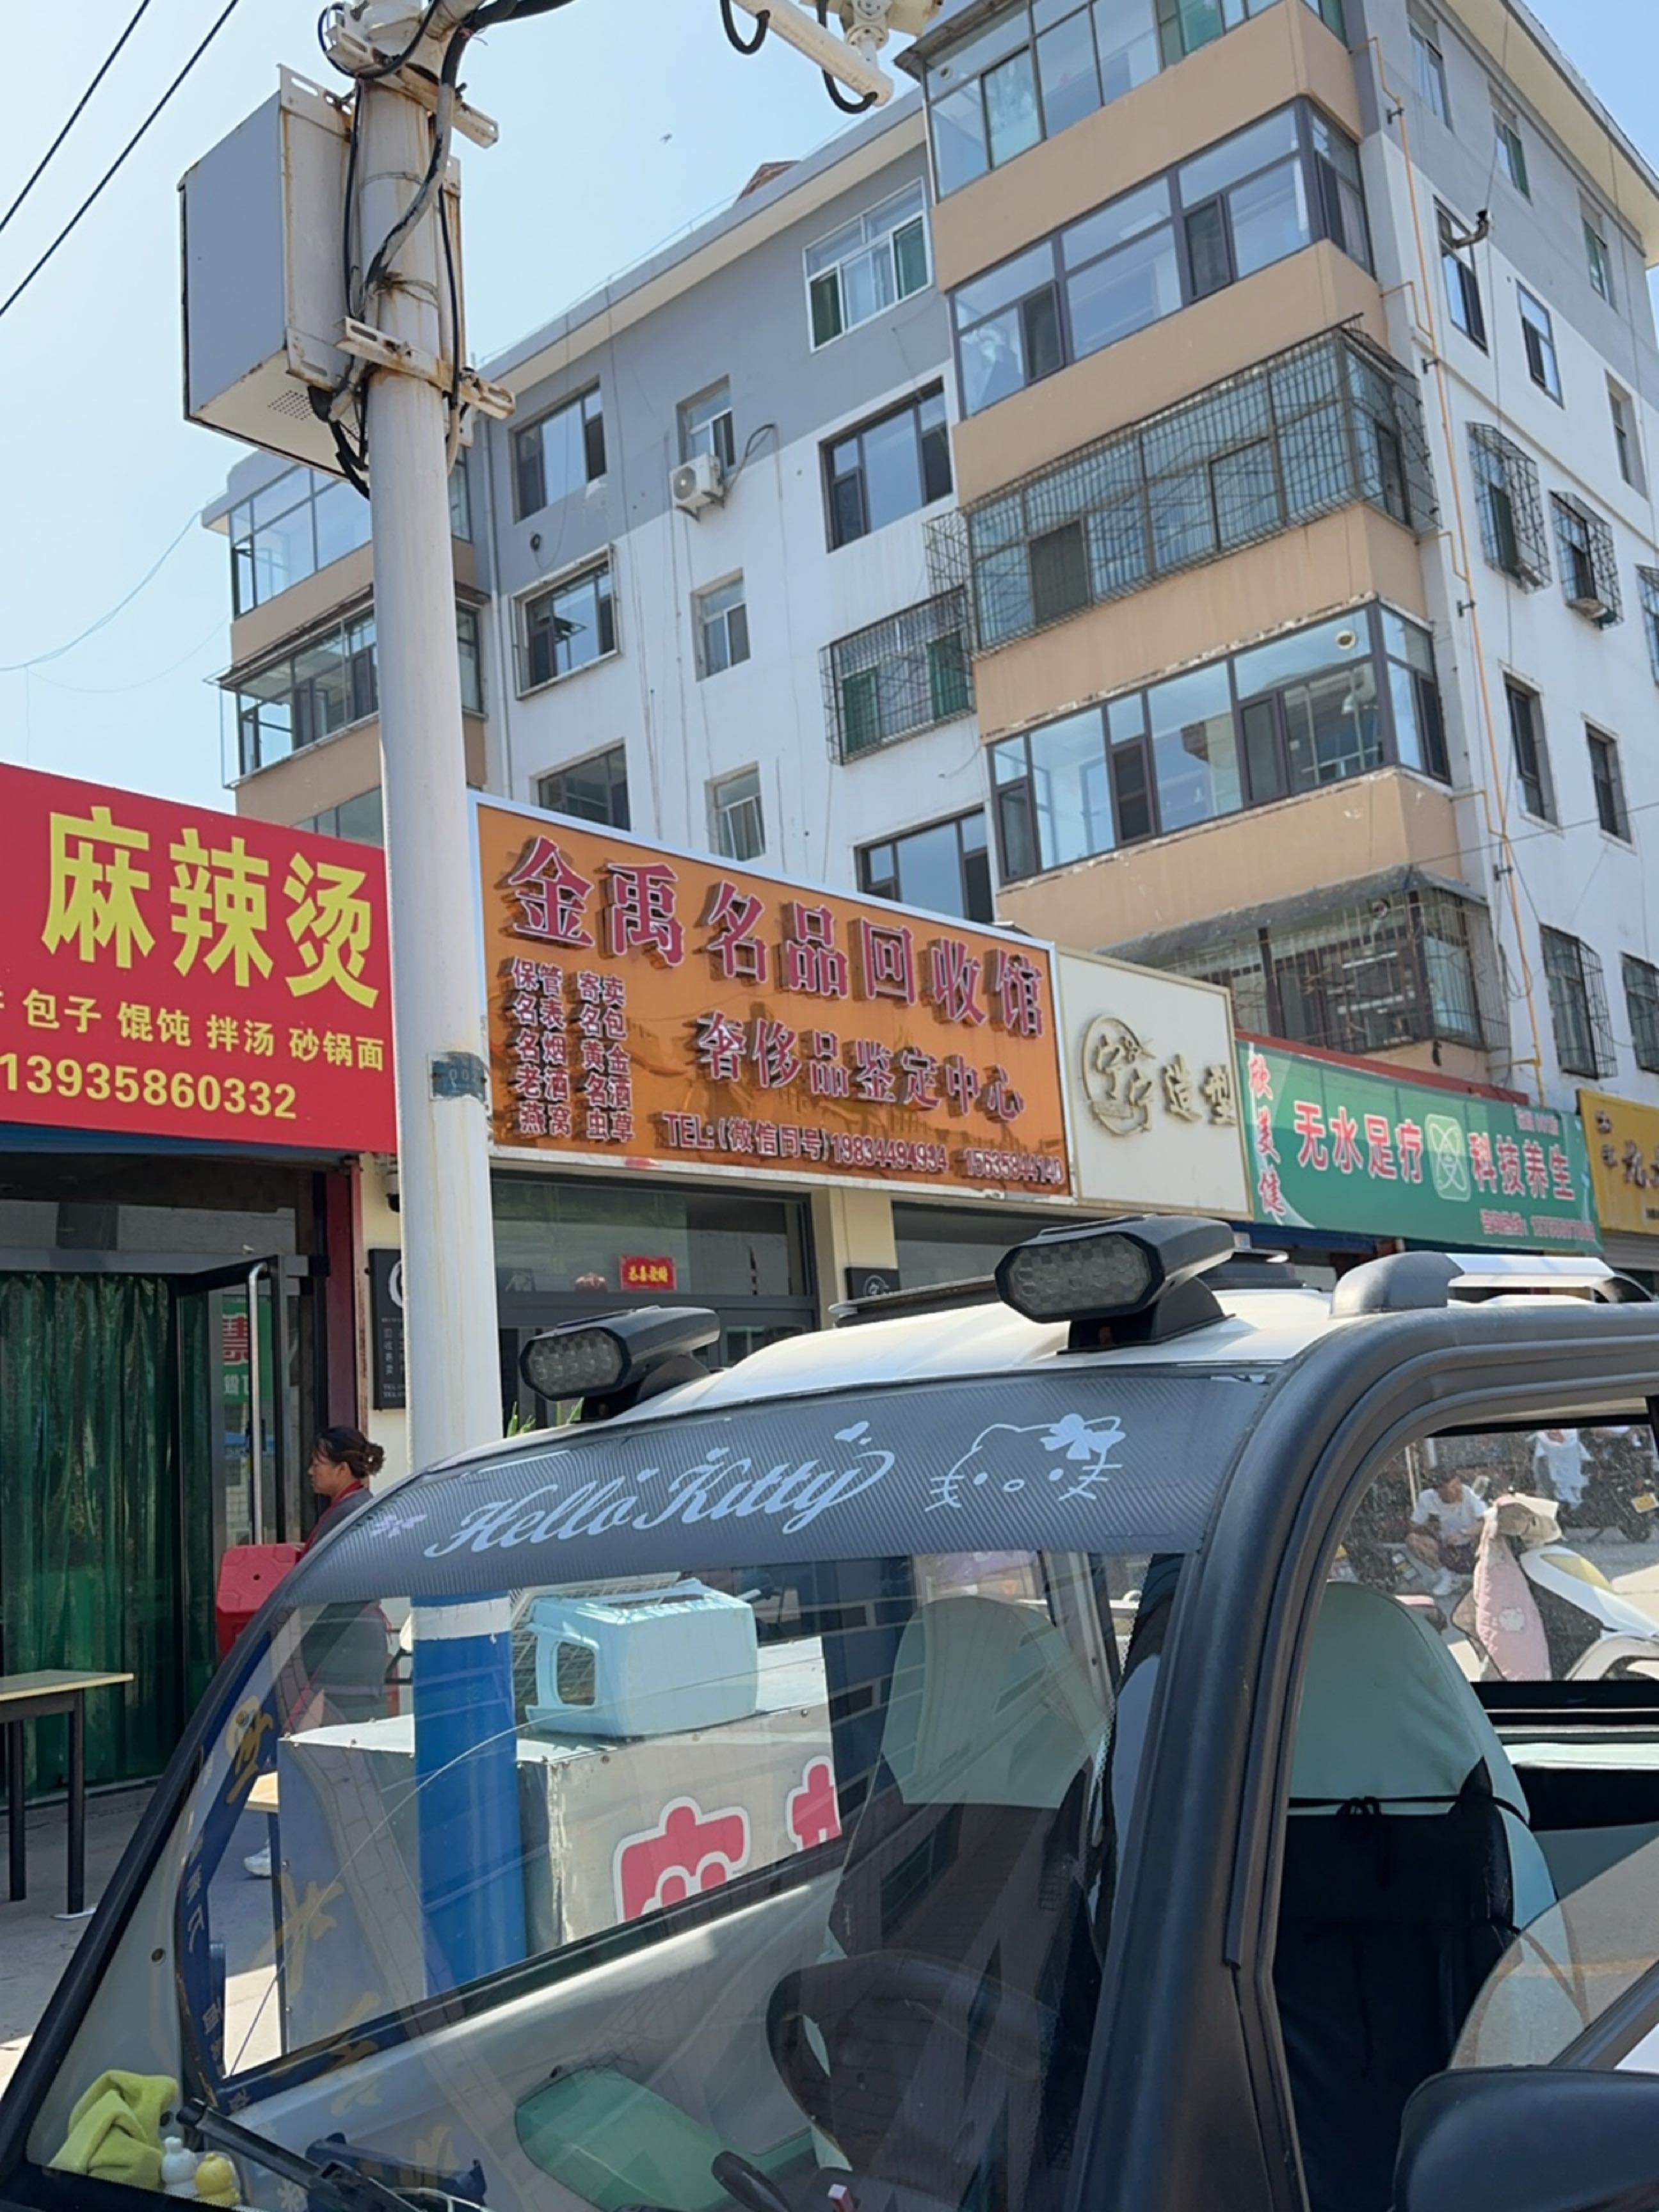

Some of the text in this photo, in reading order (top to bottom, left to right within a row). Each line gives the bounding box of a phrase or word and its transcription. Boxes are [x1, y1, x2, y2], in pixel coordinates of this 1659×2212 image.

[41, 805, 380, 1008] 麻辣烫
[509, 835, 1045, 1038] 金禹名品回收馆
[512, 958, 626, 1007] 保管 寄卖
[515, 992, 628, 1041] 名表 名包
[22, 988, 101, 1033] 包子
[116, 1001, 191, 1047] 馄饨
[206, 1015, 275, 1057] 拌汤
[289, 1027, 384, 1071] 砂锅面
[516, 1028, 630, 1077] 名烟 黄金
[698, 1010, 1025, 1123] 奢侈品鉴定中心
[0, 1053, 297, 1119] 13935860332
[517, 1064, 633, 1110] 老酒 名酒
[520, 1100, 636, 1143] 燕窝 虫草
[1293, 1100, 1424, 1183] 无水足疗
[1467, 1132, 1576, 1201] 科技养生
[424, 1447, 895, 1558] Hello Kitty
